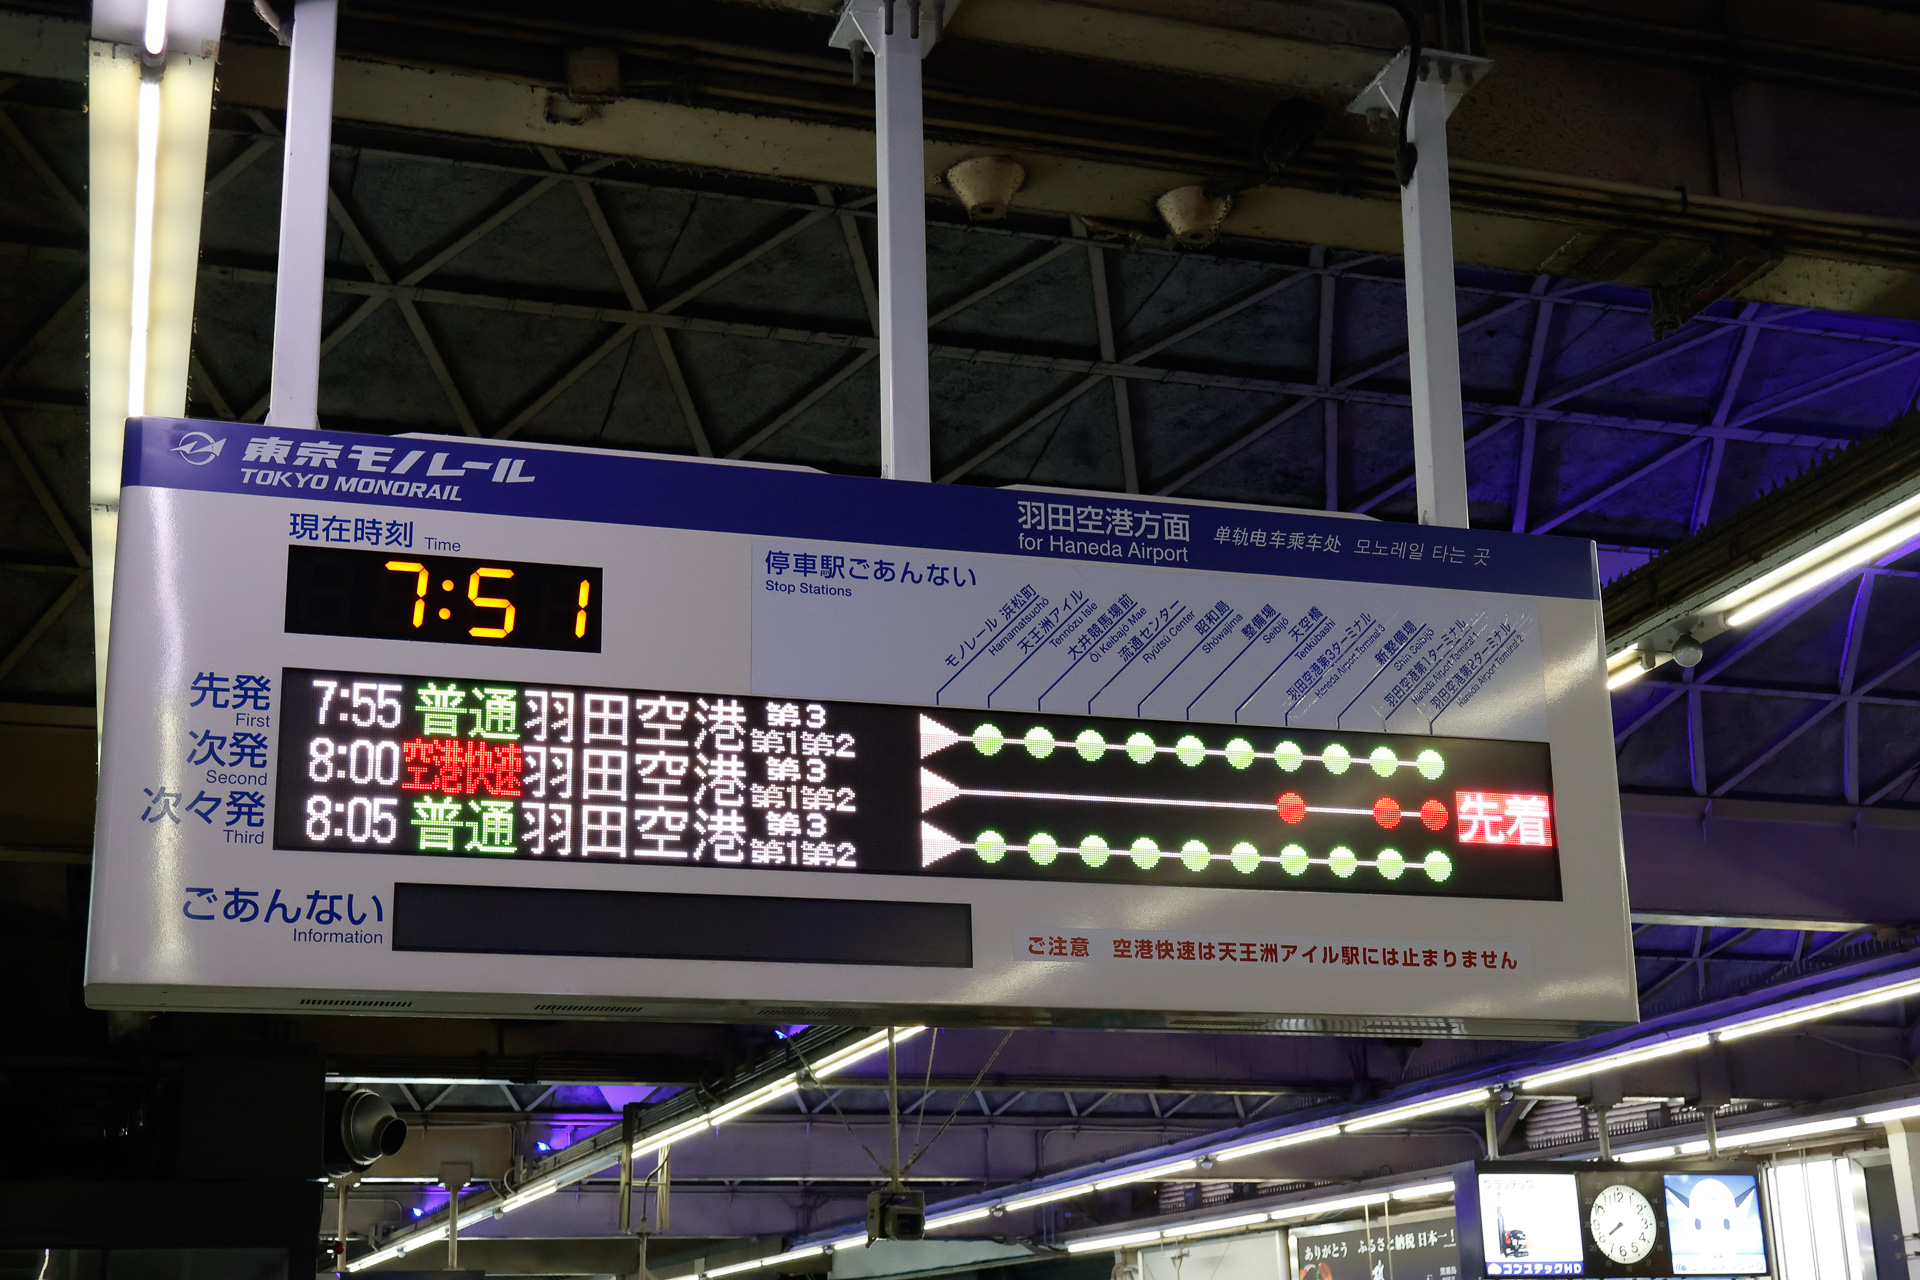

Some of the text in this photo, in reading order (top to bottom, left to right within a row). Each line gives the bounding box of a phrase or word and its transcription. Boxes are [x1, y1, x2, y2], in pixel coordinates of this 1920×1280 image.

[241, 436, 536, 484] 東京モノレール
[240, 468, 462, 501] TOKYO MONORAIL
[288, 512, 413, 548] 現在時刻
[1017, 500, 1190, 542] 羽田空港方面
[1213, 525, 1341, 553] 单轨电车乘车处
[424, 536, 461, 552] Time
[1018, 533, 1188, 563] for Haneda Airport
[1354, 538, 1491, 566] 모노레일 타는 곳
[765, 550, 977, 587] 停車駅ごあんない
[385, 561, 590, 639] 7:51
[765, 580, 852, 597] Stop Stations
[945, 584, 1037, 667] モノレール 浜松町
[988, 597, 1050, 656] Hamamatsuchō
[1017, 590, 1083, 654] 天王洲アイル
[1049, 602, 1098, 648] Tennōzu Isle
[1067, 593, 1134, 661] 大井競馬場前
[1117, 600, 1179, 662] 流通センター
[1127, 607, 1147, 628] Mae
[1168, 610, 1196, 638] Center
[1194, 600, 1231, 636] 昭和島
[1202, 612, 1244, 655] Shōwajima
[1240, 603, 1277, 641] 整備場
[1288, 605, 1324, 643] 天空橋
[1286, 612, 1372, 701] 羽田空港第3ターミナル
[1294, 618, 1336, 661] Tenkūbashi
[1374, 619, 1418, 666] 新整備場
[1384, 619, 1466, 707] 羽田空港第1ターミナル
[1393, 653, 1412, 672] Shin
[1430, 622, 1511, 710] 羽田空港第2ターミナル
[190, 672, 272, 711] 先発
[235, 713, 271, 728] First
[313, 680, 747, 751] 7:55 普通 羽田空港
[186, 729, 268, 769] 次発
[750, 728, 856, 758] 第1第2
[206, 769, 268, 787] Second
[309, 737, 747, 807] 8:00 空港快速 羽田空港
[141, 786, 266, 828] 次々発
[750, 783, 856, 812] 第1第2
[223, 829, 264, 845] Third
[306, 795, 747, 863] 8:05 普通 羽田空港
[1459, 793, 1550, 845] 先着
[750, 838, 857, 867] 第1第2
[182, 887, 383, 926] ごあんない
[293, 928, 383, 945] Information
[1027, 936, 1518, 970] ご注意 空港快速は天王洲アイル駅には止まりません
[1304, 1241, 1349, 1261] ありがとう
